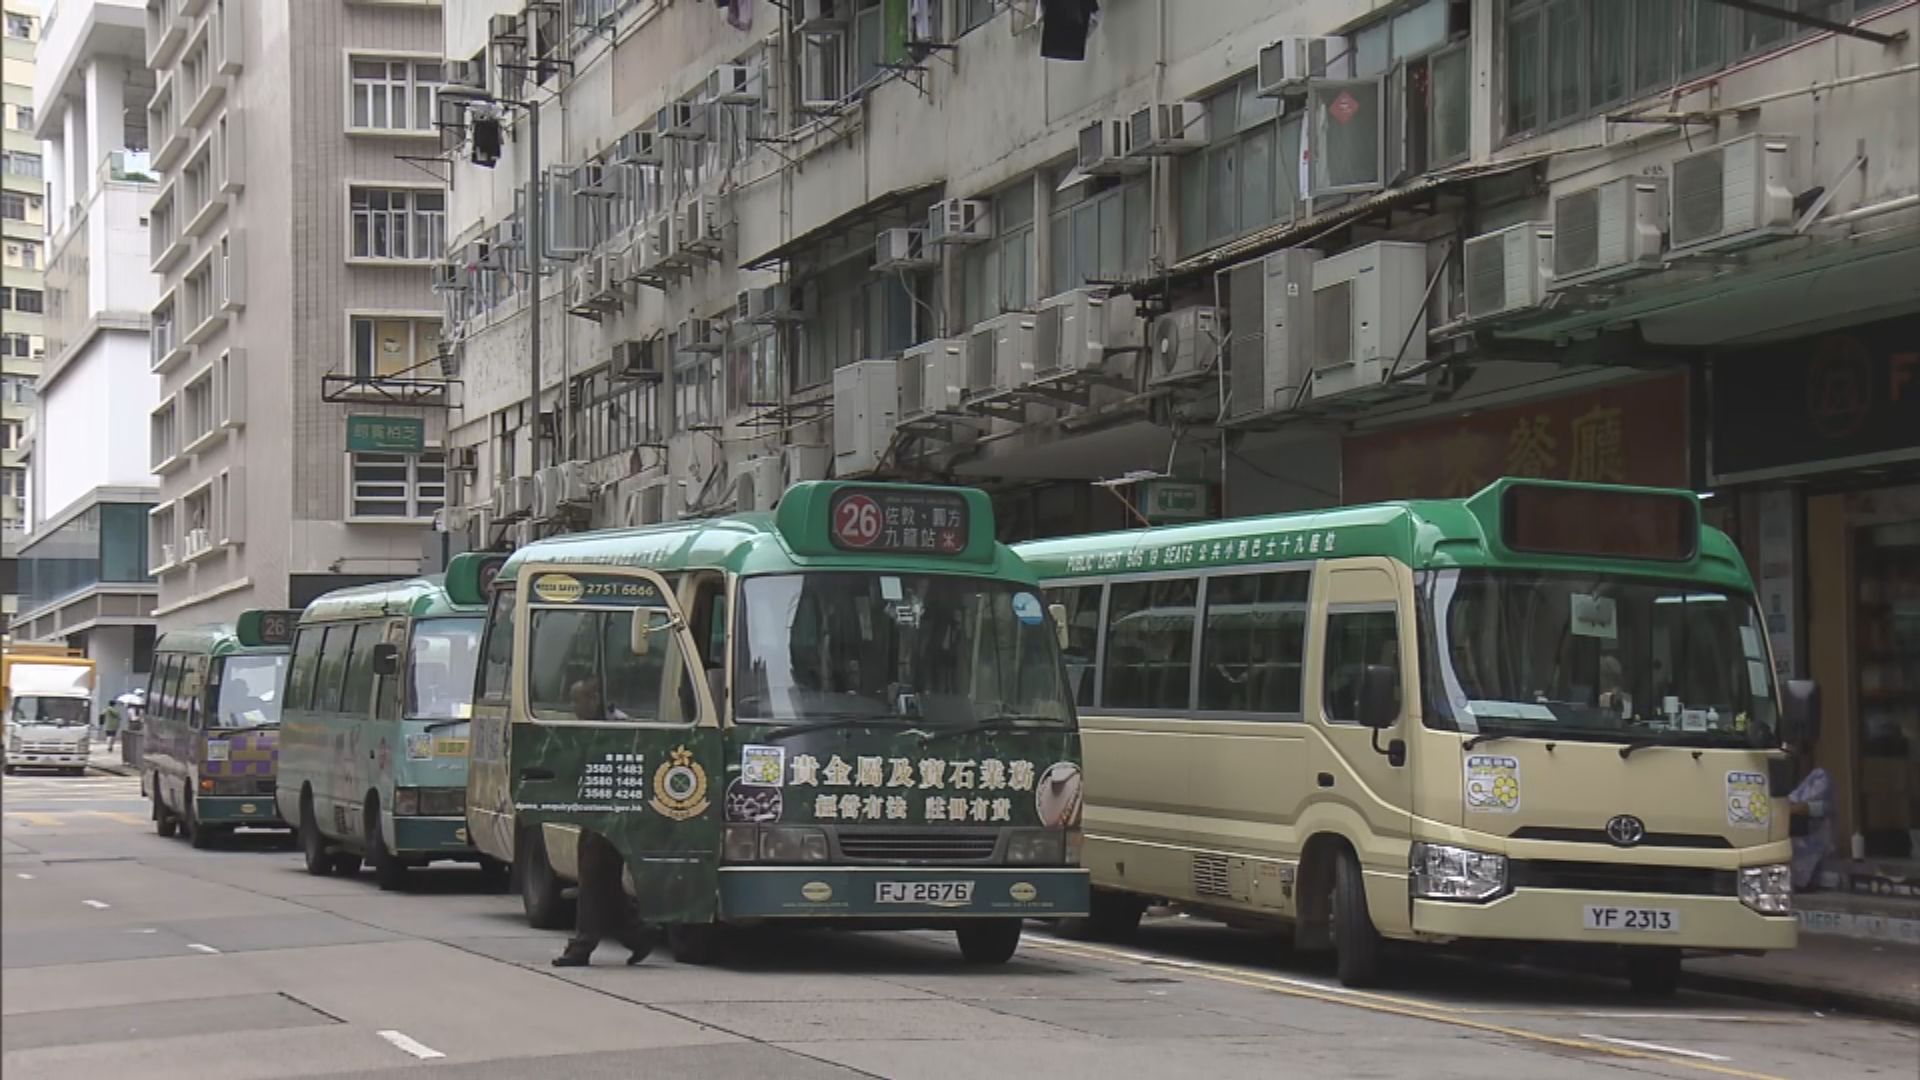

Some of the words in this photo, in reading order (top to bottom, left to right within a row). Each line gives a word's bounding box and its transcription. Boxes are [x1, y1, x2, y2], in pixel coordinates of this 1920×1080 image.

[841, 503, 878, 538] 26
[1066, 553, 1094, 573] PUBLIC
[1098, 551, 1123, 570] LIGHT
[1126, 550, 1144, 568] BUS
[1163, 544, 1194, 564] SEATS
[587, 583, 617, 595] 2751
[621, 583, 654, 596] 6666
[880, 883, 907, 901] FJ
[913, 883, 968, 901] 2676
[1591, 908, 1618, 928] YF
[1624, 908, 1672, 930] 2313
